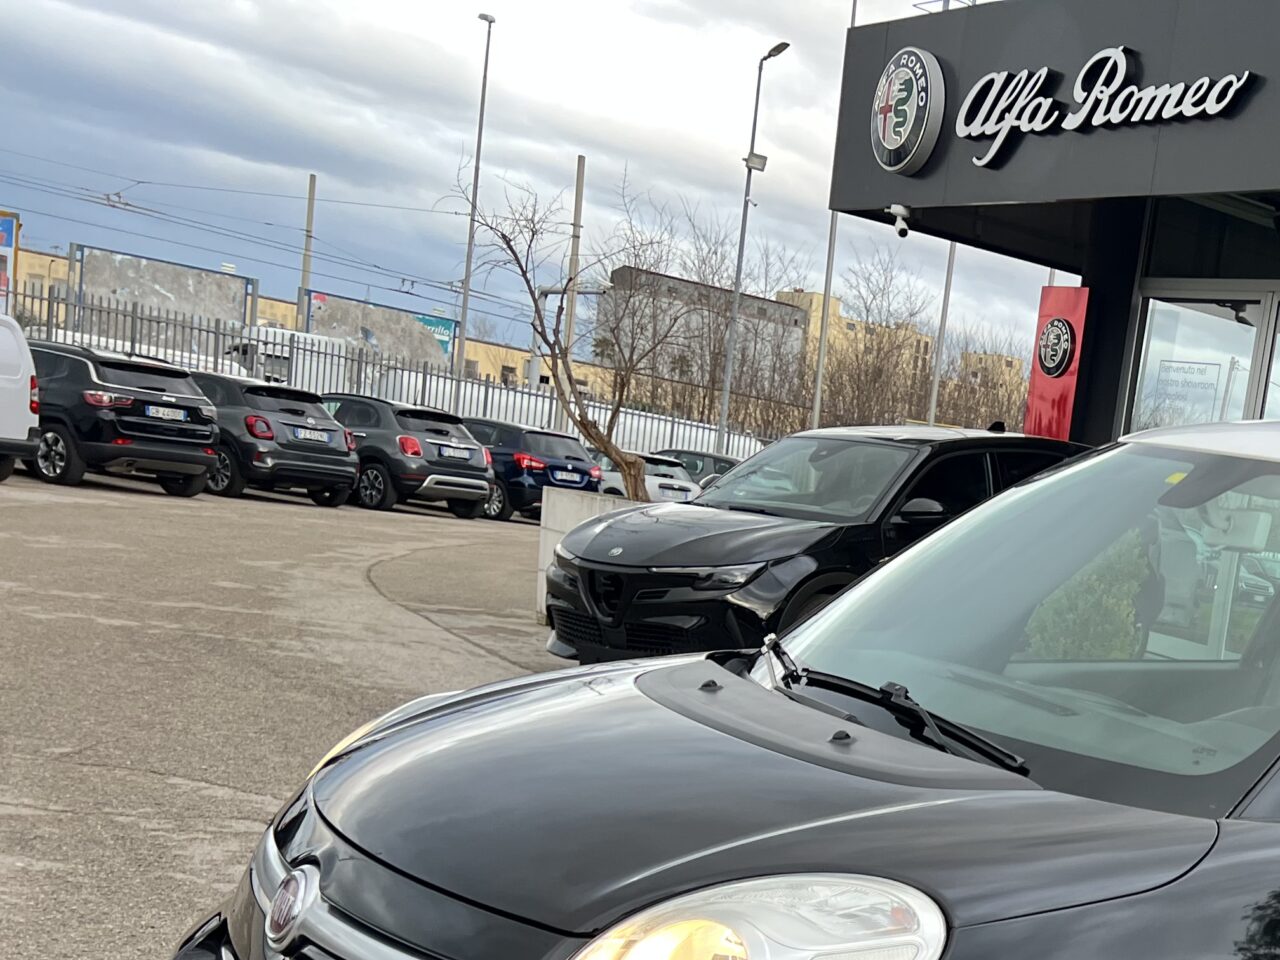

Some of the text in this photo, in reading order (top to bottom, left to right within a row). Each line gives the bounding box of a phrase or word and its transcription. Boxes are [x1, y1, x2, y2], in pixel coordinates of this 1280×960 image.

[900, 54, 927, 107] ROMEO
[955, 45, 1250, 167] Alfa Romeo
